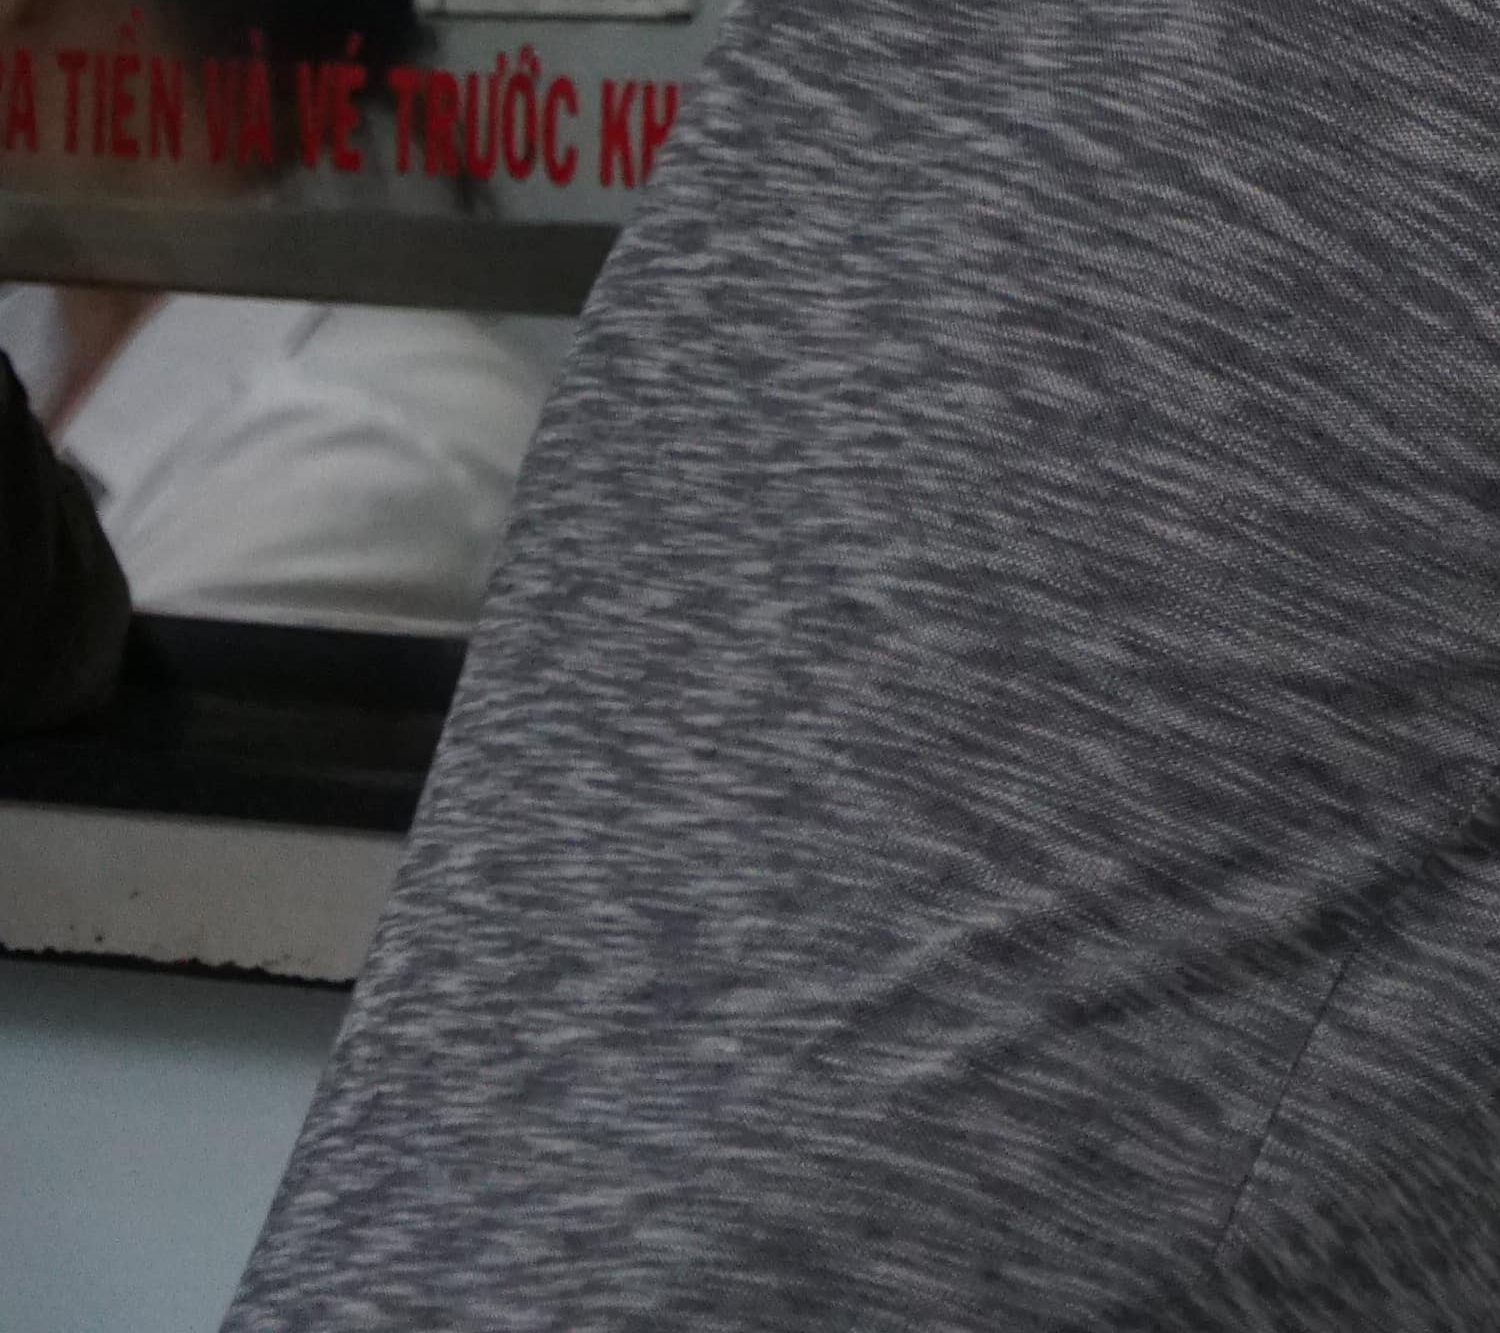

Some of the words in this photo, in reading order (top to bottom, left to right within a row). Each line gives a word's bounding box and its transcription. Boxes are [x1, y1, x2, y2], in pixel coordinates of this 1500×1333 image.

[204, 28, 274, 165] VÀ
[296, 30, 366, 172] VÉ
[387, 42, 579, 188] TRƯỚC
[599, 77, 680, 191] KH
